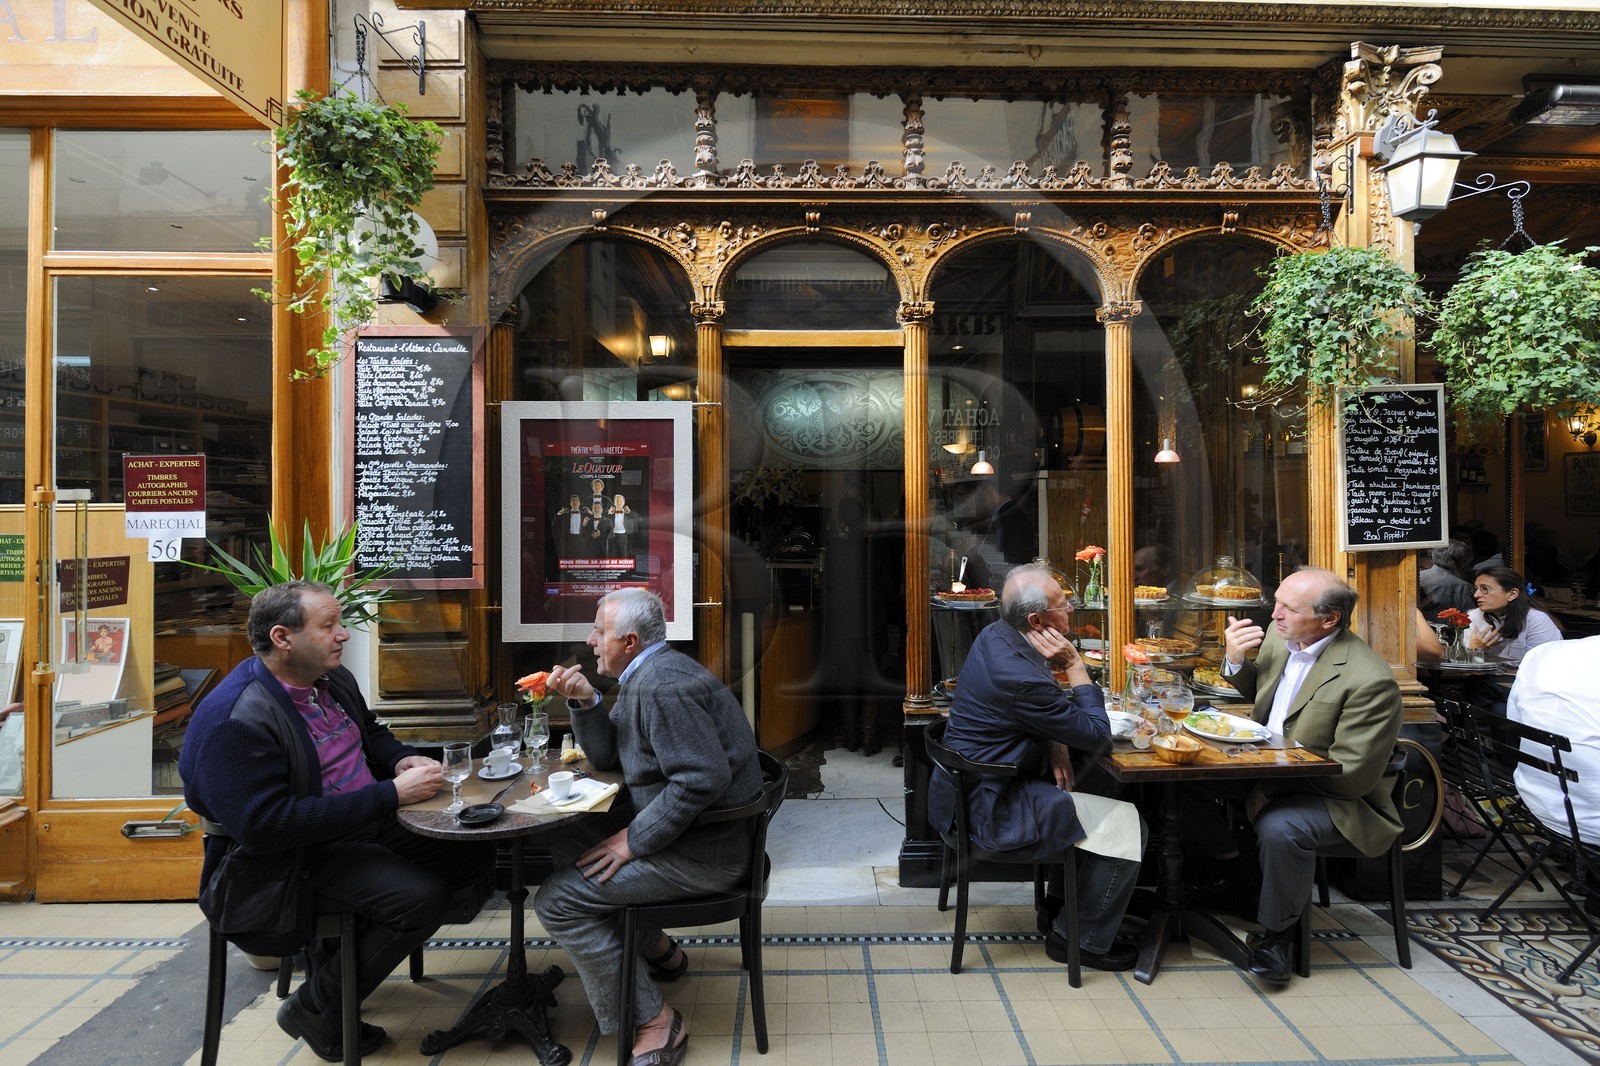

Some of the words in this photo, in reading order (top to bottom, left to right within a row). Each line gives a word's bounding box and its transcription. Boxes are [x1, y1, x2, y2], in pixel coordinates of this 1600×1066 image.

[157, 0, 210, 48] VENTE
[167, 26, 244, 93] GRATUITE
[358, 342, 398, 352] Restaurant
[432, 343, 468, 352] Cannelle
[368, 356, 388, 364] Tartes
[357, 412, 368, 420] Les
[357, 441, 381, 449] Salade
[572, 463, 584, 473] LE
[584, 461, 623, 474] QUATUOR
[1383, 505, 1390, 514] et
[127, 519, 204, 530] MARECHAL
[151, 539, 178, 560] 56
[93, 560, 126, 568] EXPERTISE
[98, 586, 122, 594] ANCIENS
[91, 594, 119, 602] POSTALES
